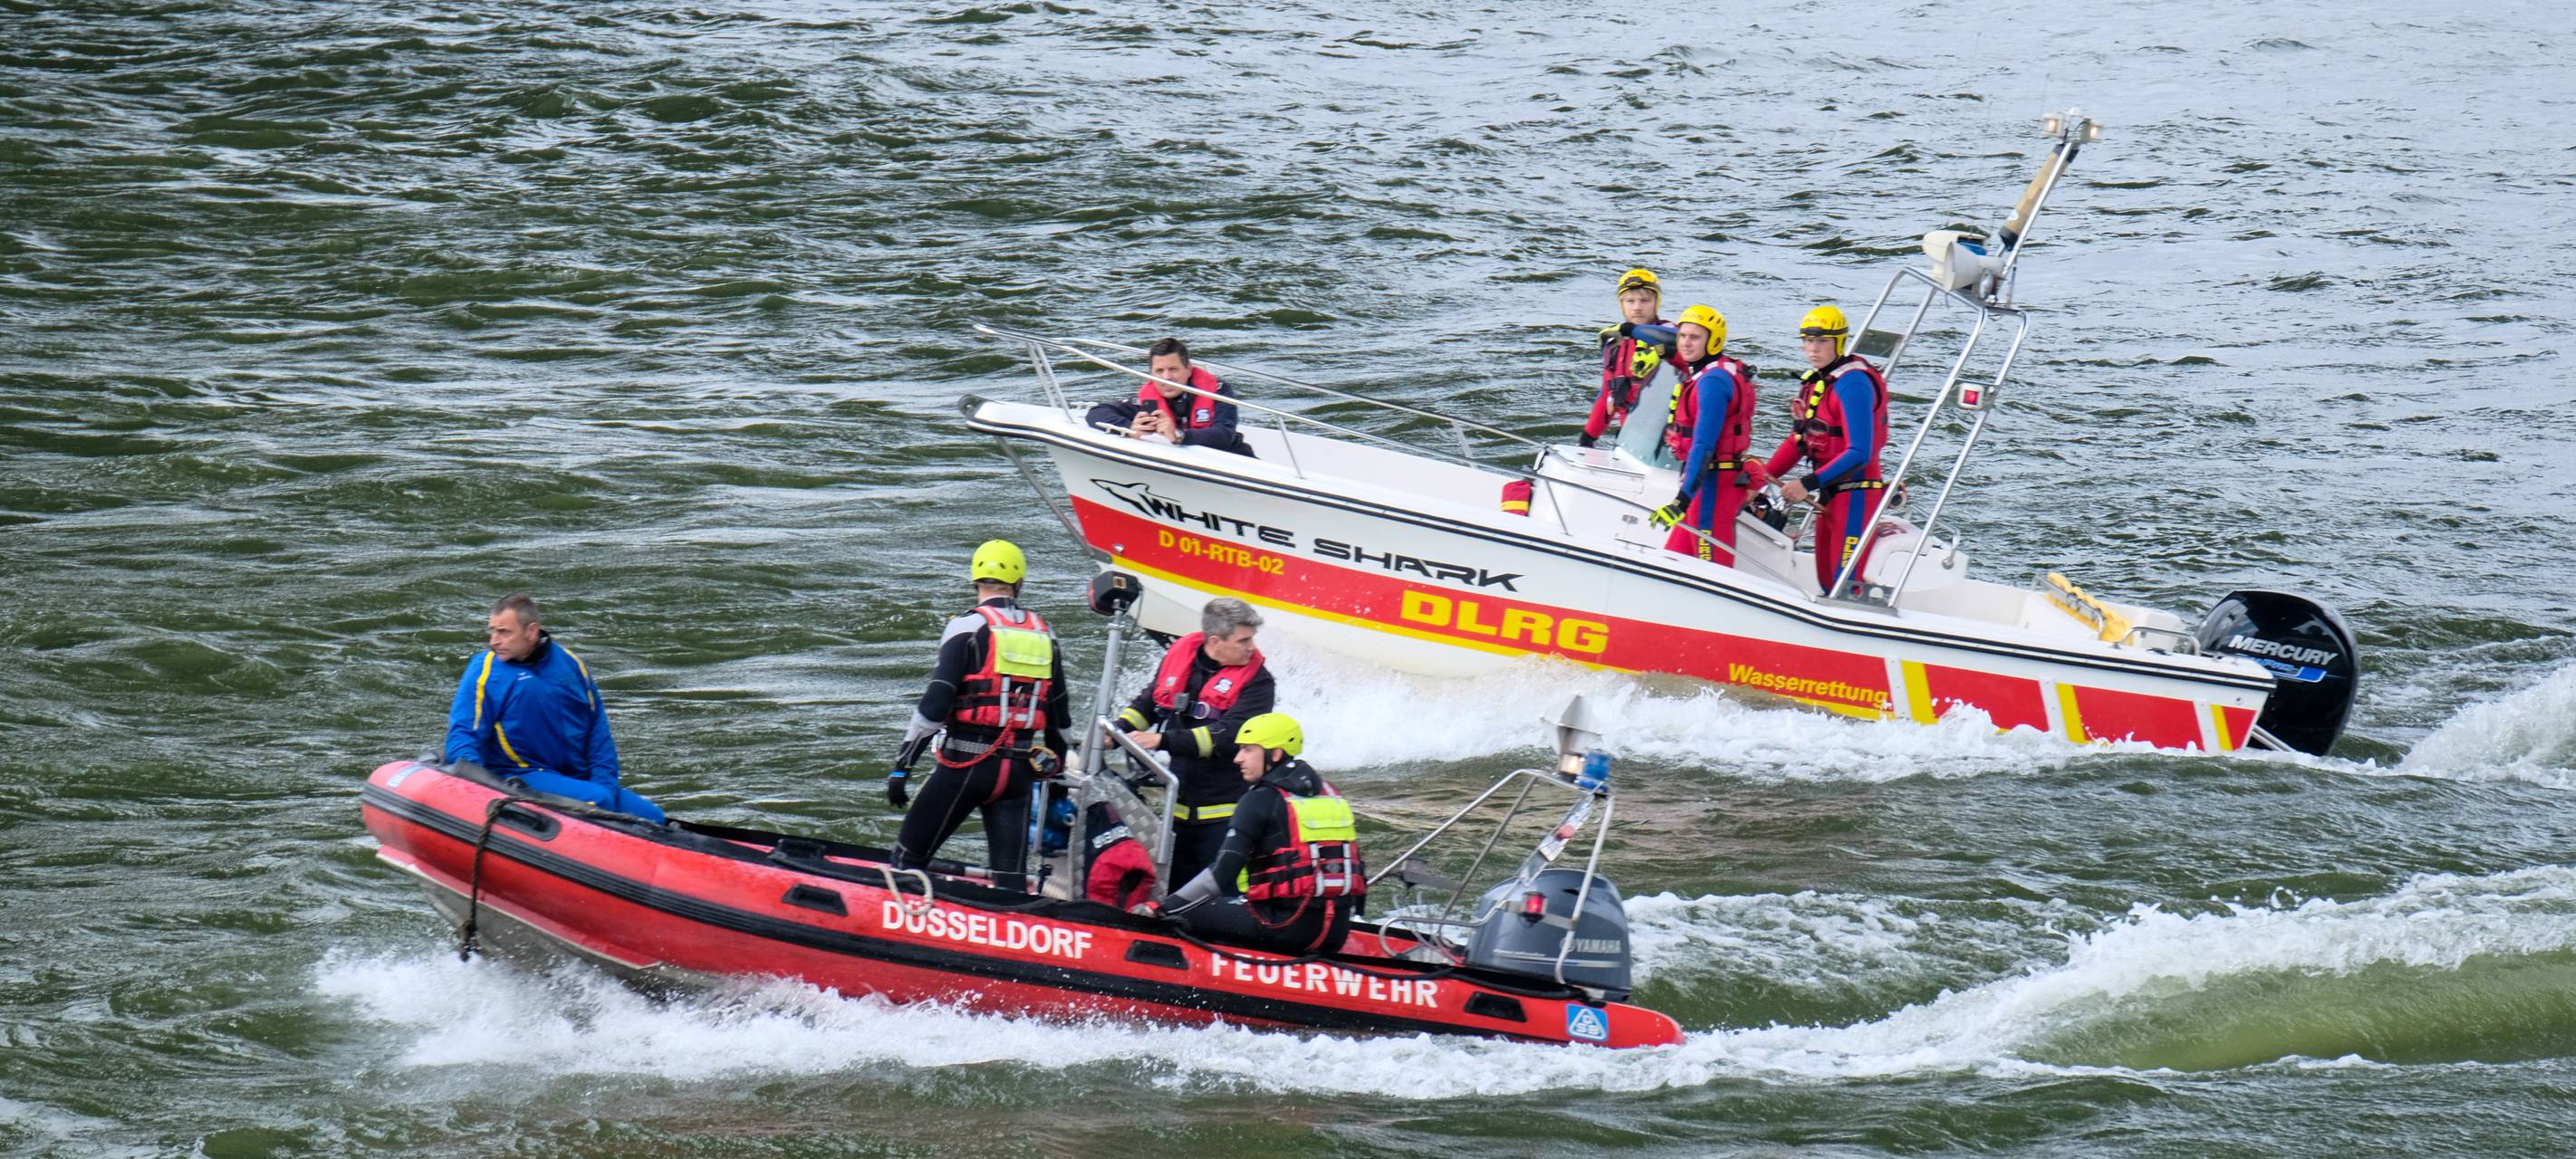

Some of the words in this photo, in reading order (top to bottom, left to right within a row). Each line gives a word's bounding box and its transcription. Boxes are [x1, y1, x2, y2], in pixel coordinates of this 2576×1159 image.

[1139, 492, 1296, 549] WHITE
[1312, 537, 1526, 593] SHARK
[1158, 530, 1175, 549] D
[1179, 536, 1285, 576] 01-RTB-02
[1400, 589, 1610, 655] DLRG
[2228, 634, 2339, 666] MERCURY
[1728, 663, 1889, 709] Wasserrettung
[882, 899, 1094, 960] DÜSSELDORF
[1576, 938, 1621, 953] YAMAHA
[1210, 952, 1438, 1009] FEUERWEHR
